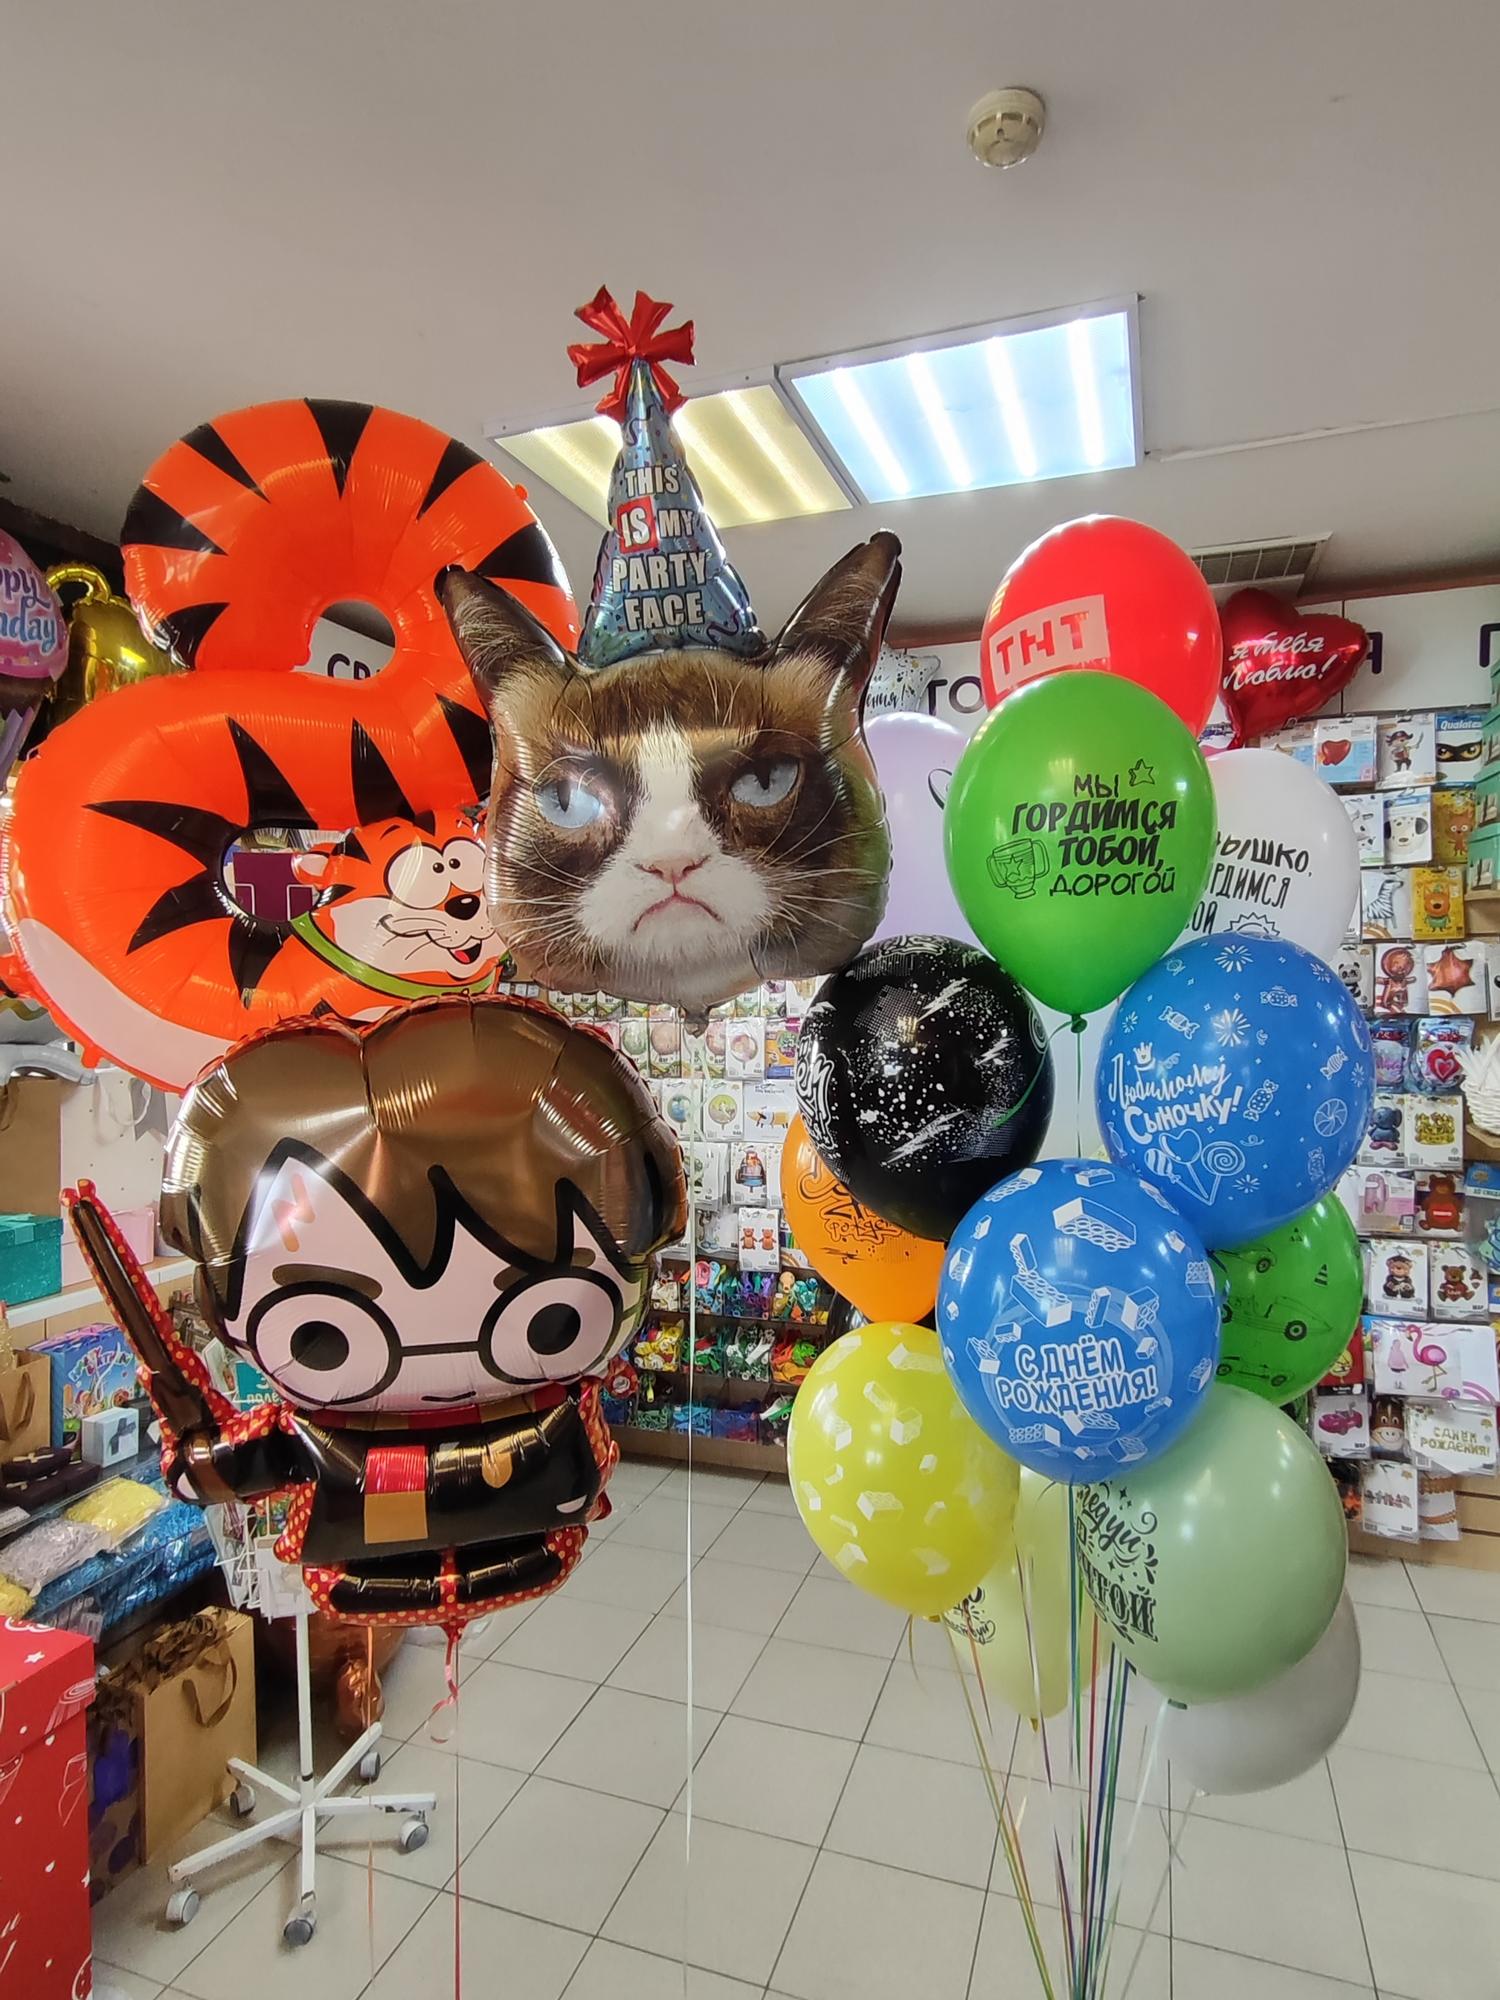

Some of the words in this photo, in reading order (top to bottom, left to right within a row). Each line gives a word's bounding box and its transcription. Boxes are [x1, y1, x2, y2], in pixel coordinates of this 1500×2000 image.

[625, 465, 680, 498] THIS
[620, 506, 650, 548] IS
[659, 508, 693, 538] MY
[612, 551, 707, 593] PARTY
[624, 592, 705, 632] FACE
[1254, 632, 1325, 657] тебя
[1222, 653, 1338, 691] Люблю!
[1074, 774, 1120, 798] МЫ
[1012, 799, 1177, 835] ГОРДИМСЯ
[1217, 832, 1312, 877] ЫШКО,
[1050, 867, 1176, 896] ДОРОГОЙ
[1108, 1053, 1232, 1110] Любимому
[1015, 1343, 1038, 1382] С
[1041, 1333, 1125, 1383] ДНЁМ
[996, 1365, 1159, 1416] РОЖДЕНИЯ!
